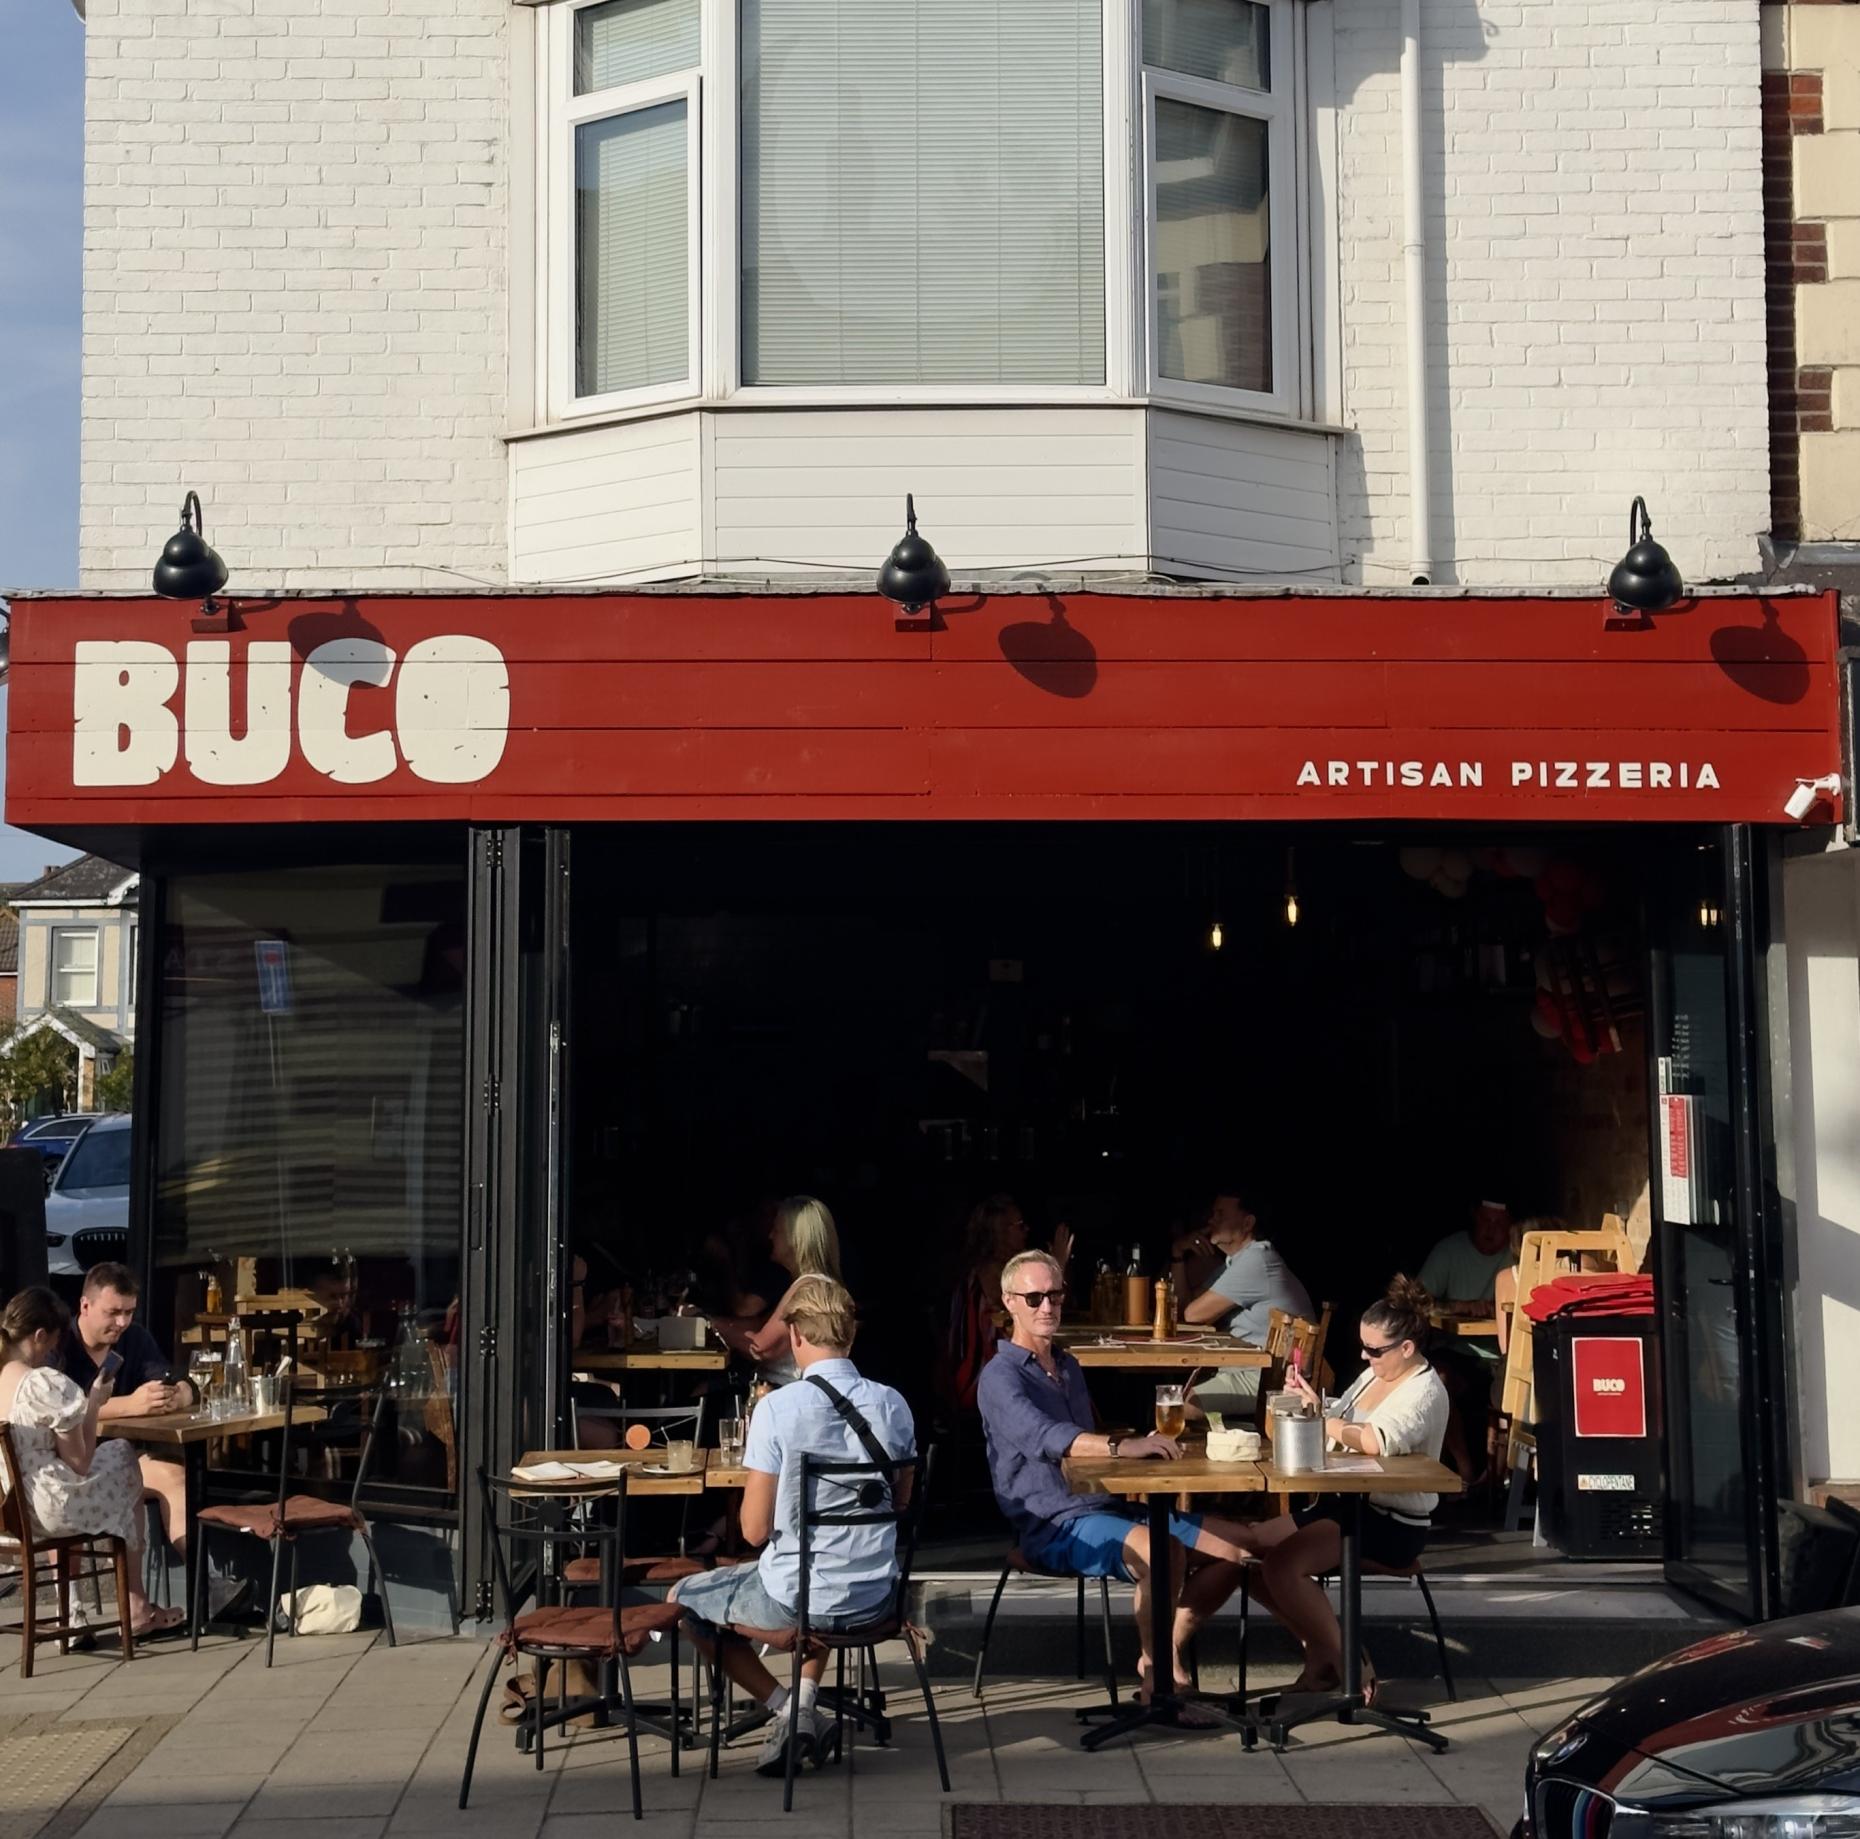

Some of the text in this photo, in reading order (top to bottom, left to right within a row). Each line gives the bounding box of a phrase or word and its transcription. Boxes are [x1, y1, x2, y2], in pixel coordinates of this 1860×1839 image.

[74, 635, 511, 786] BUCO
[1297, 762, 1720, 788] ARTISAN PIZZERIA
[1593, 1378, 1625, 1392] BUCO
